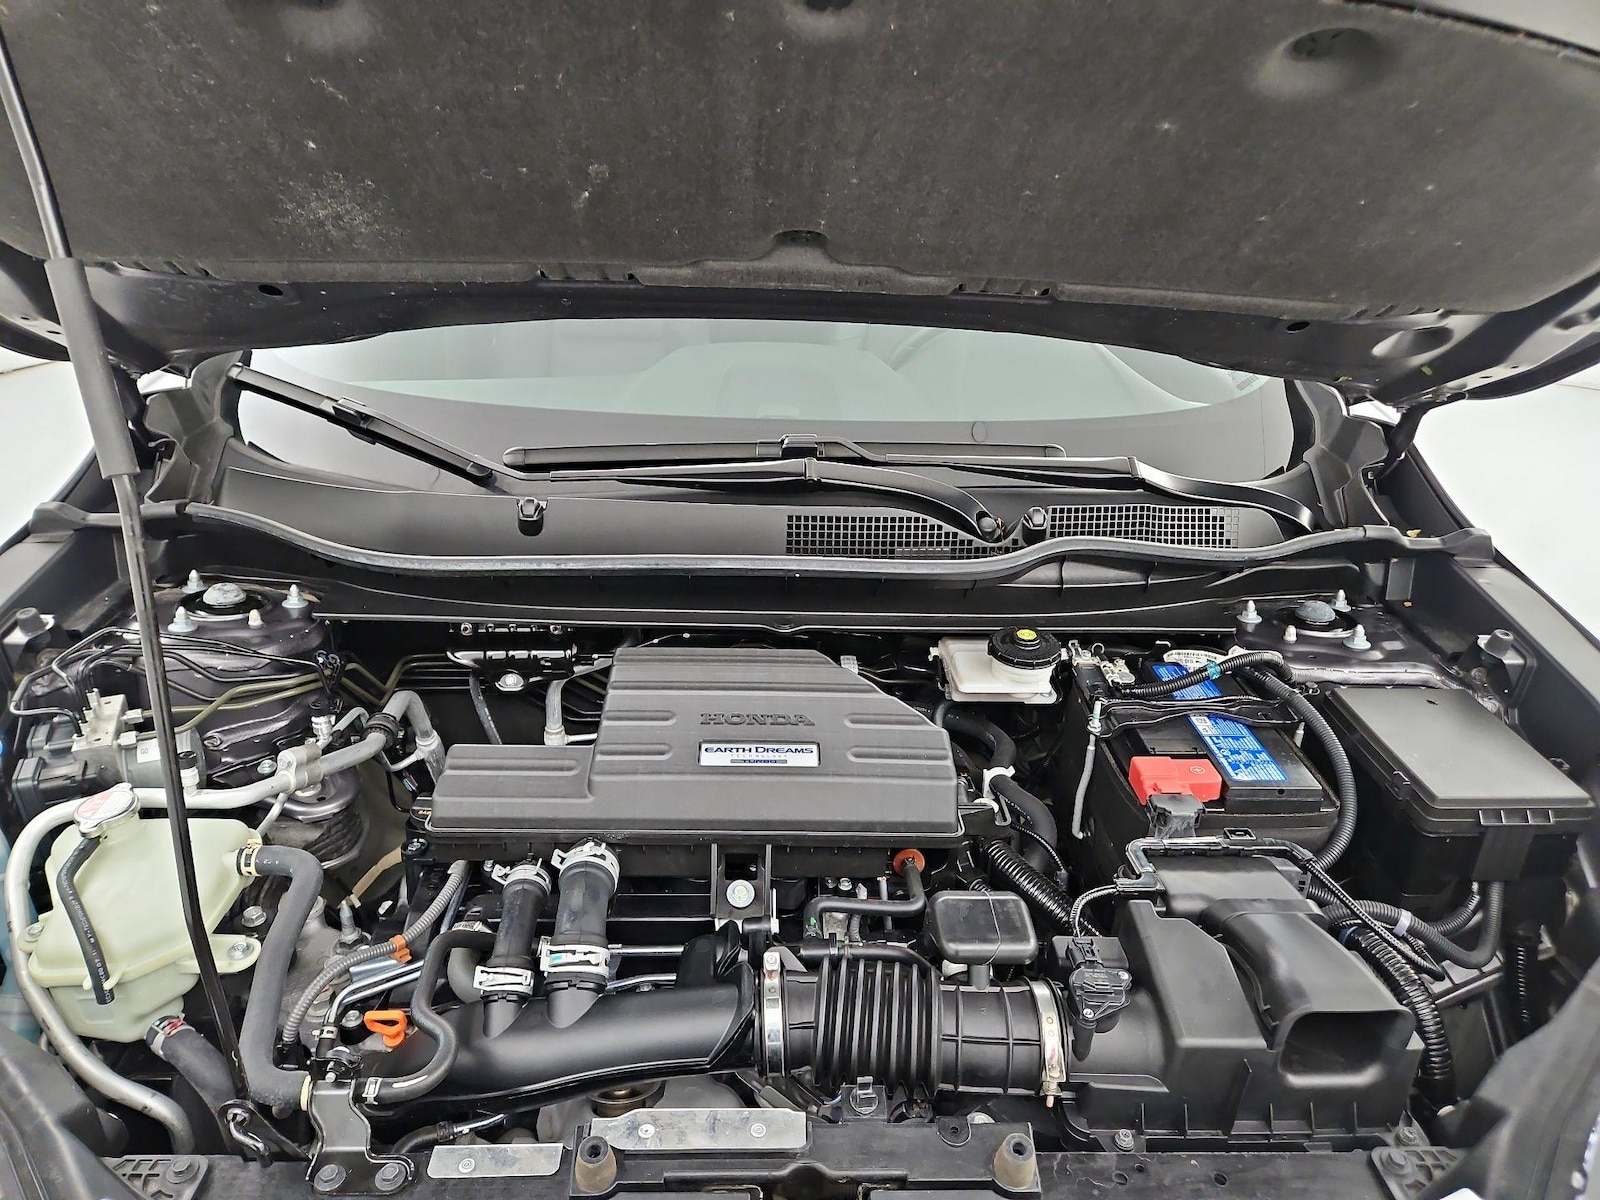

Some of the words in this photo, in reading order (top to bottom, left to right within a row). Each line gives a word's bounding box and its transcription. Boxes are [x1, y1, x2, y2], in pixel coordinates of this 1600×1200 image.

[700, 713, 815, 726] HONDA
[704, 746, 752, 754] EARTH
[755, 746, 814, 754] DREAMS
